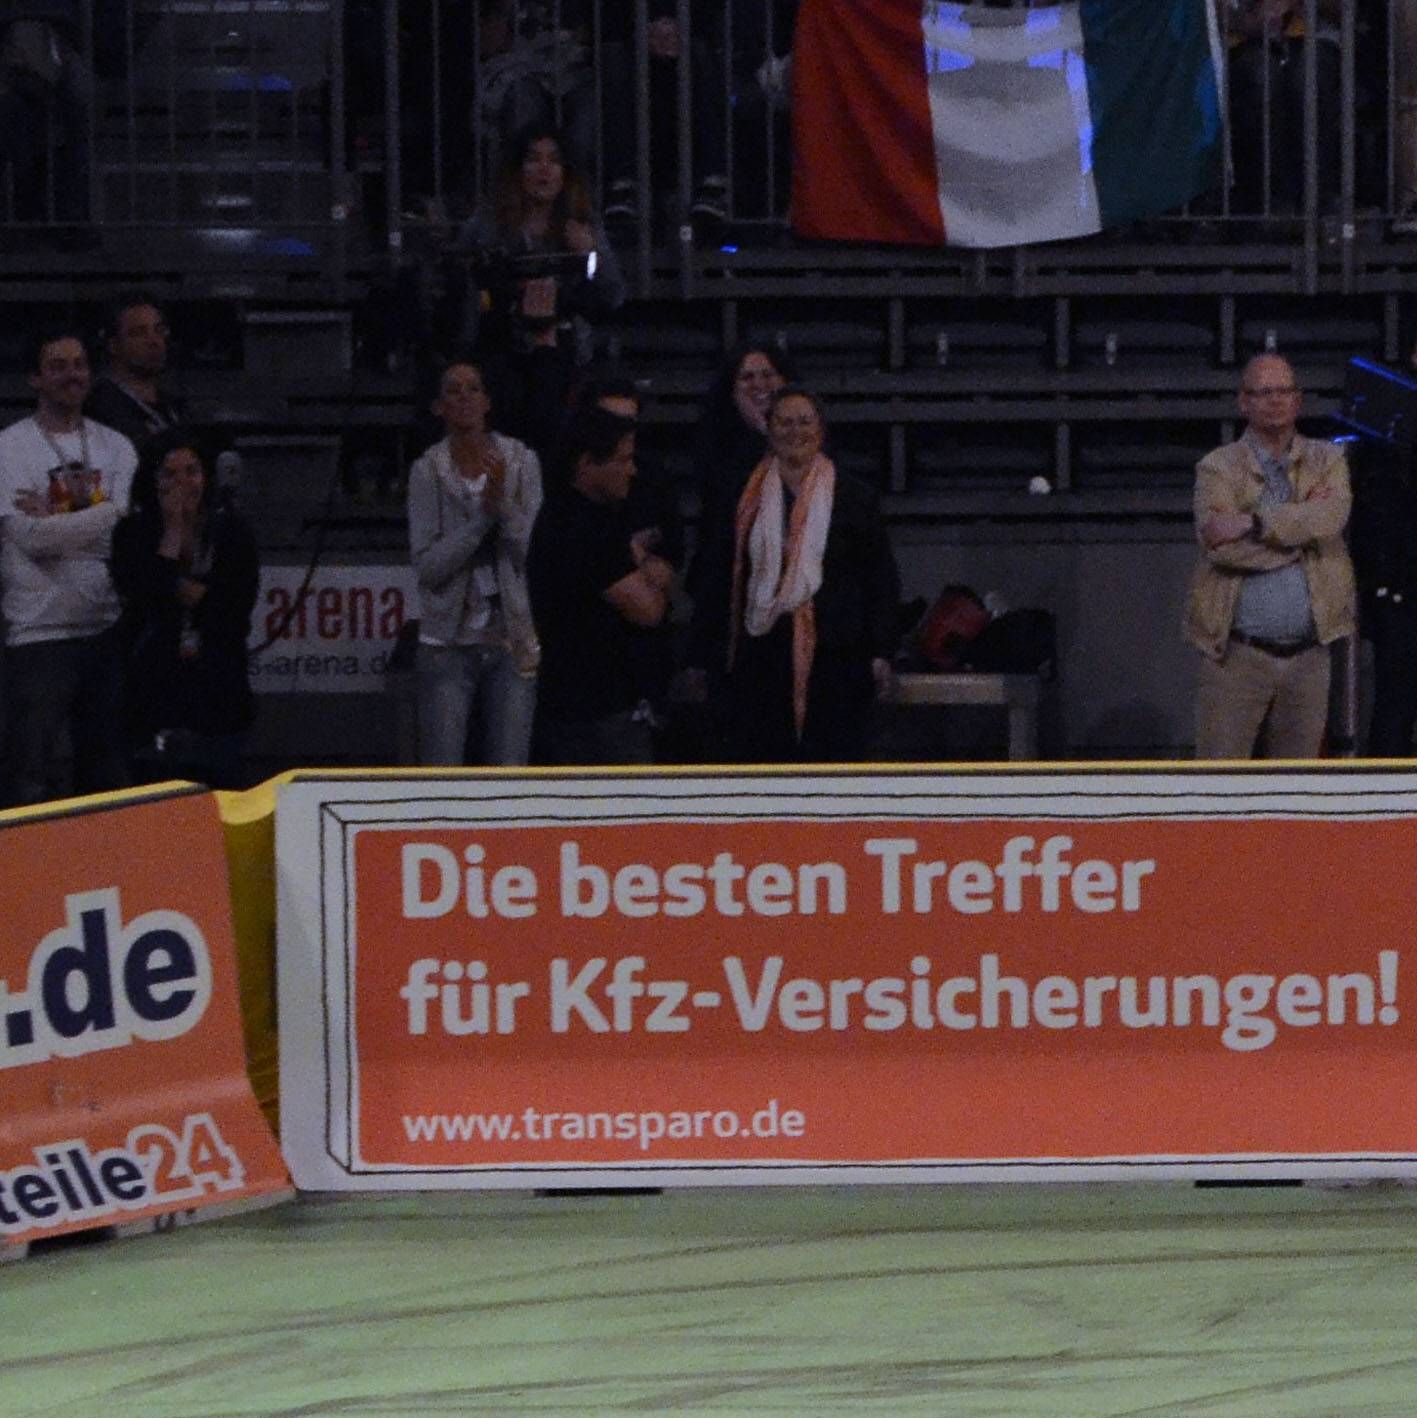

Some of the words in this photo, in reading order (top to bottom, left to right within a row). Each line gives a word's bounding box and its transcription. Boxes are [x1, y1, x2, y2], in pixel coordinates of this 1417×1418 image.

[264, 587, 405, 640] arena
[402, 843, 538, 918] Die
[560, 842, 847, 917] besten
[864, 836, 1156, 914] Treffer
[400, 958, 531, 1036] für
[550, 950, 1401, 1052] Kfz-Versicherungen!
[402, 1099, 806, 1150] www.transparo.de
